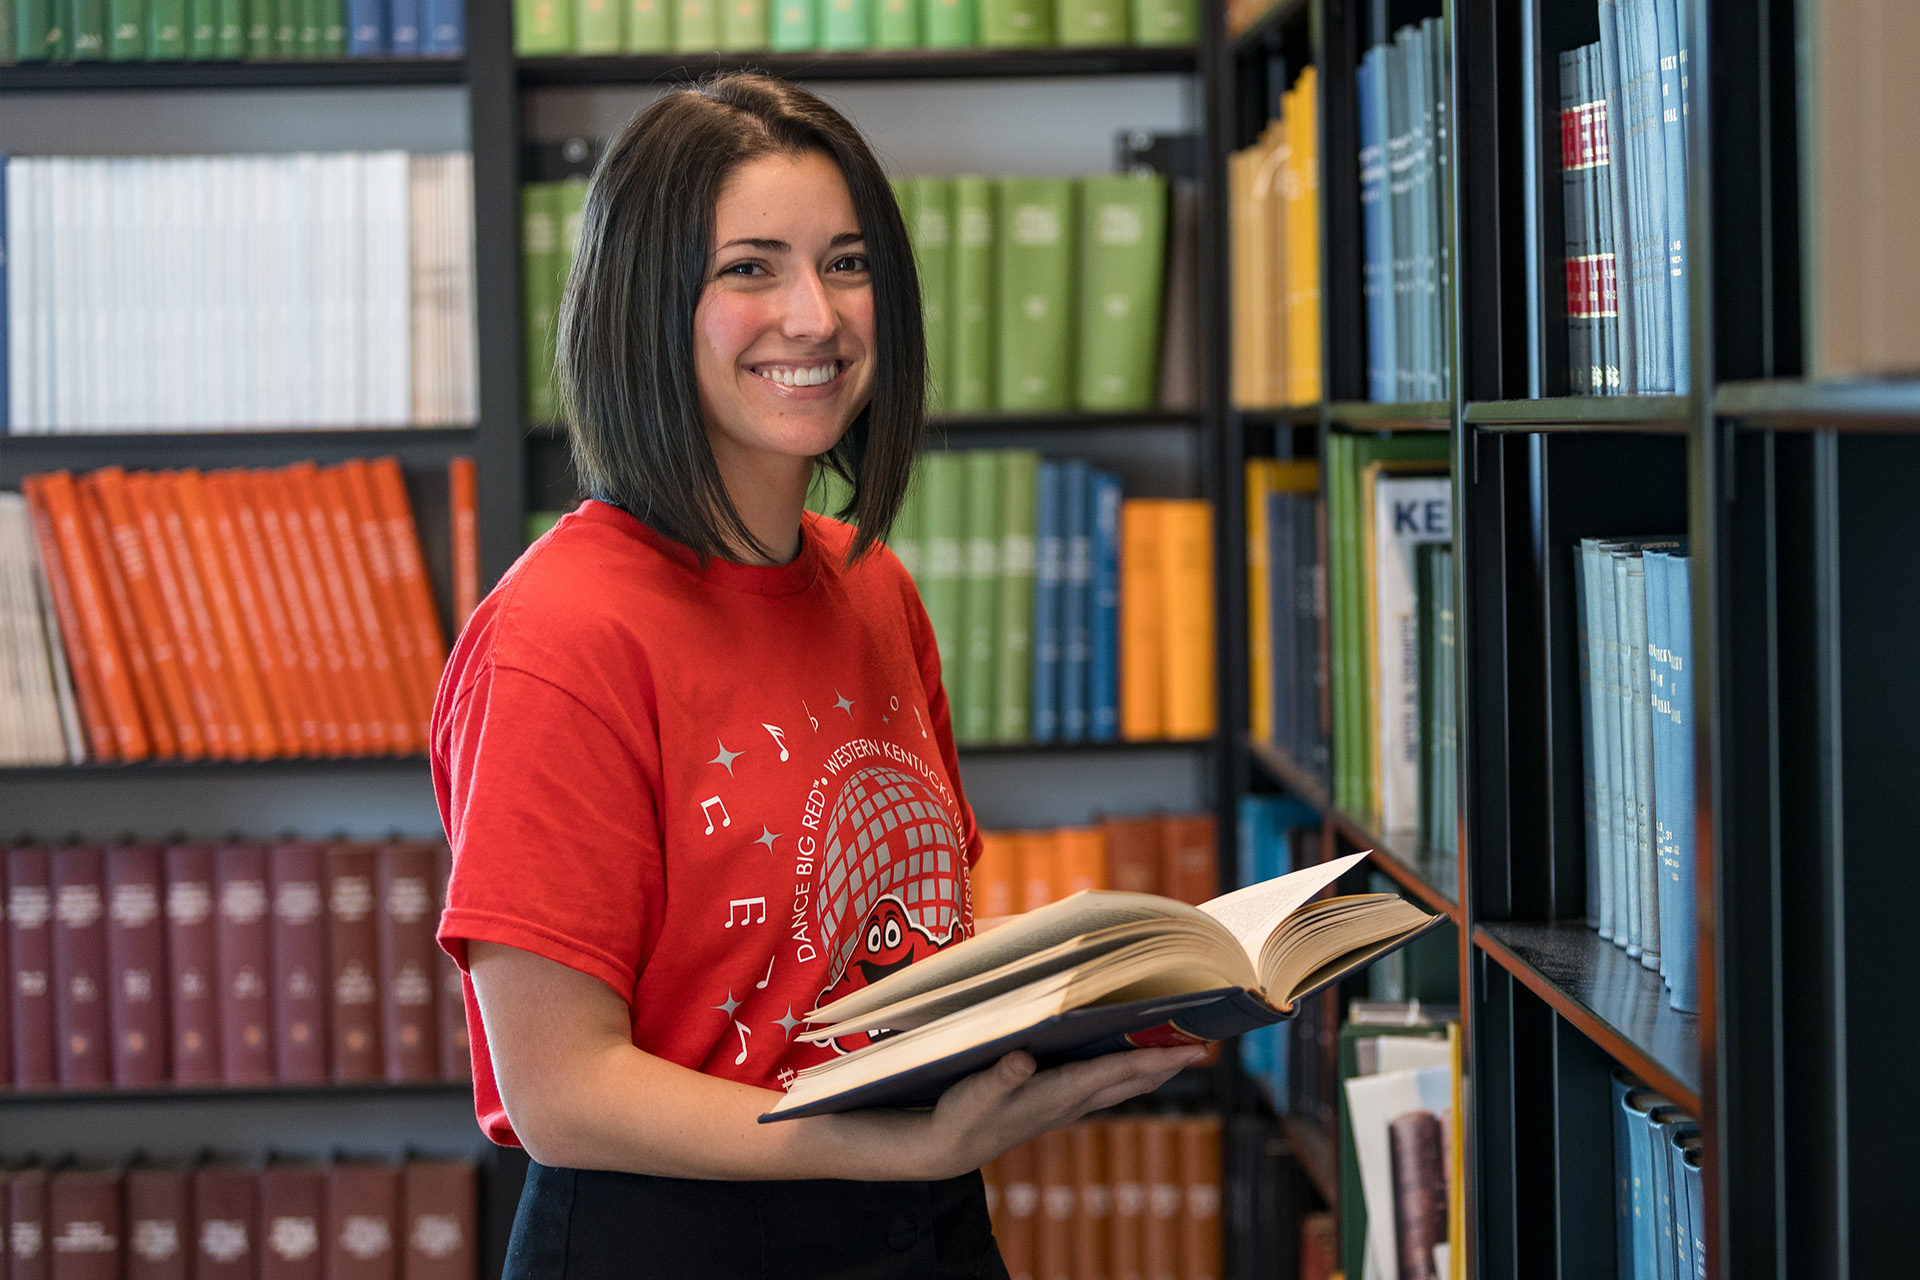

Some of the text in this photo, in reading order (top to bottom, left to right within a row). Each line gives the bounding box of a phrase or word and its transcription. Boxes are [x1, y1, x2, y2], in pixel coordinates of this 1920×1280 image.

[823, 739, 881, 776] WESTERN
[882, 741, 952, 806] KENTUCKY
[796, 836, 815, 875] BIG
[953, 811, 973, 936] UNIVERSITY
[791, 882, 816, 963] DANCE
